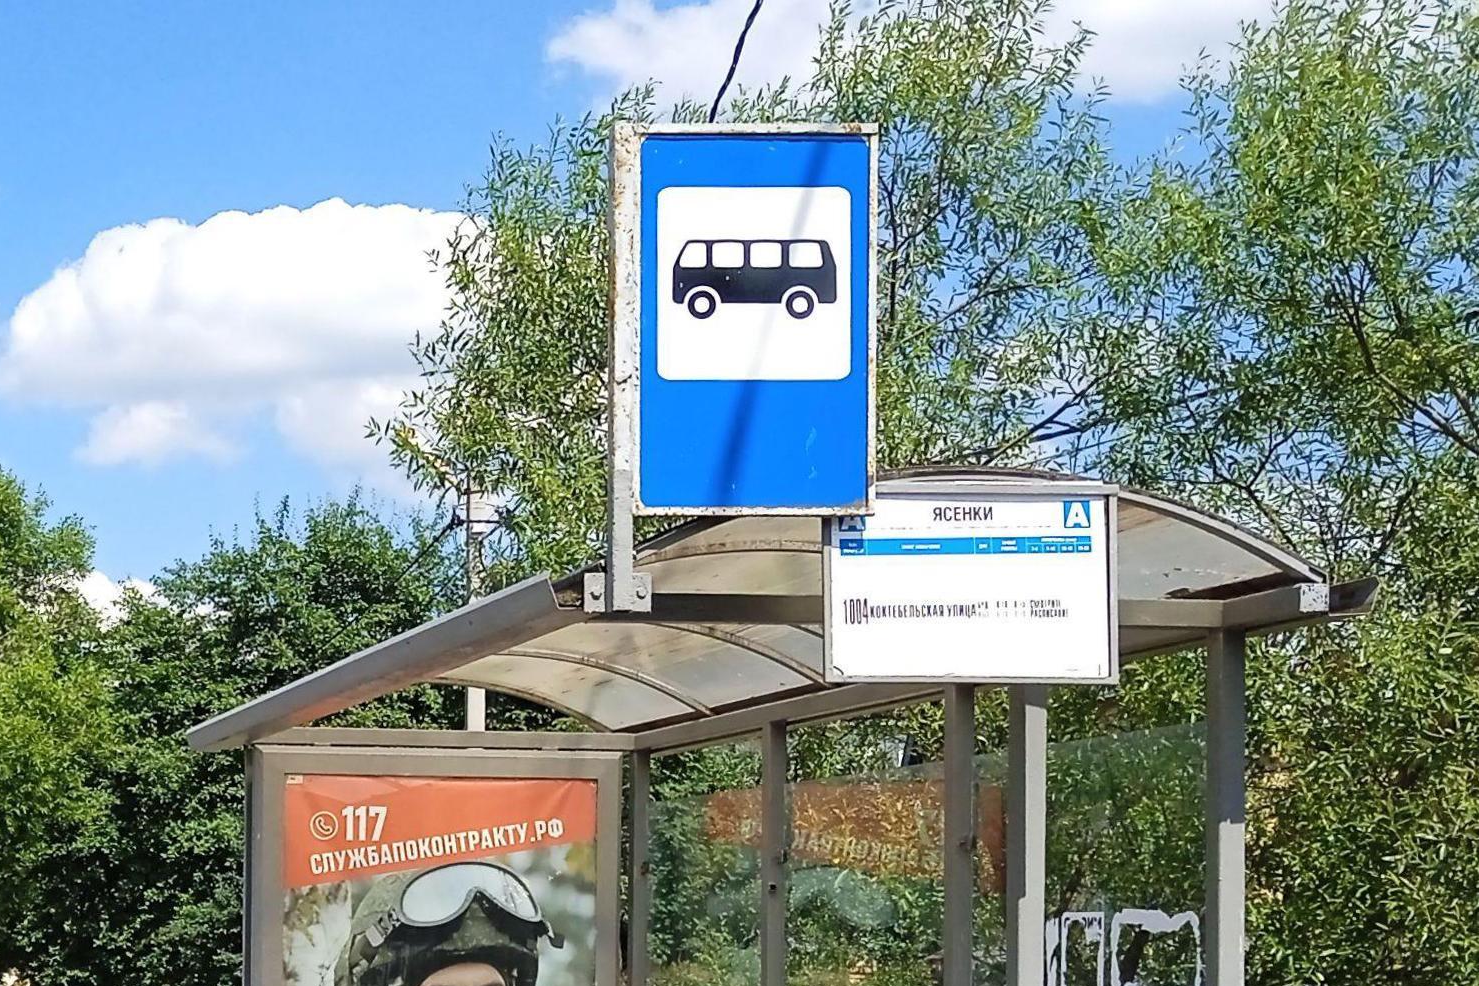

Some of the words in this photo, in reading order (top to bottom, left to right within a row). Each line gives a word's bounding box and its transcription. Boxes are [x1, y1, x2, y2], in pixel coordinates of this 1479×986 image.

[932, 506, 994, 521] ЯСЕНКИ
[1064, 501, 1091, 528] А
[843, 598, 869, 624] 1004
[869, 604, 945, 618] КОКТЕБЕЛЬСКАЯ
[946, 604, 977, 618] УЛИЦА
[341, 805, 387, 842] 117
[309, 818, 565, 875] СЛУЖБАПОКОНТРАКТУ.РФ
